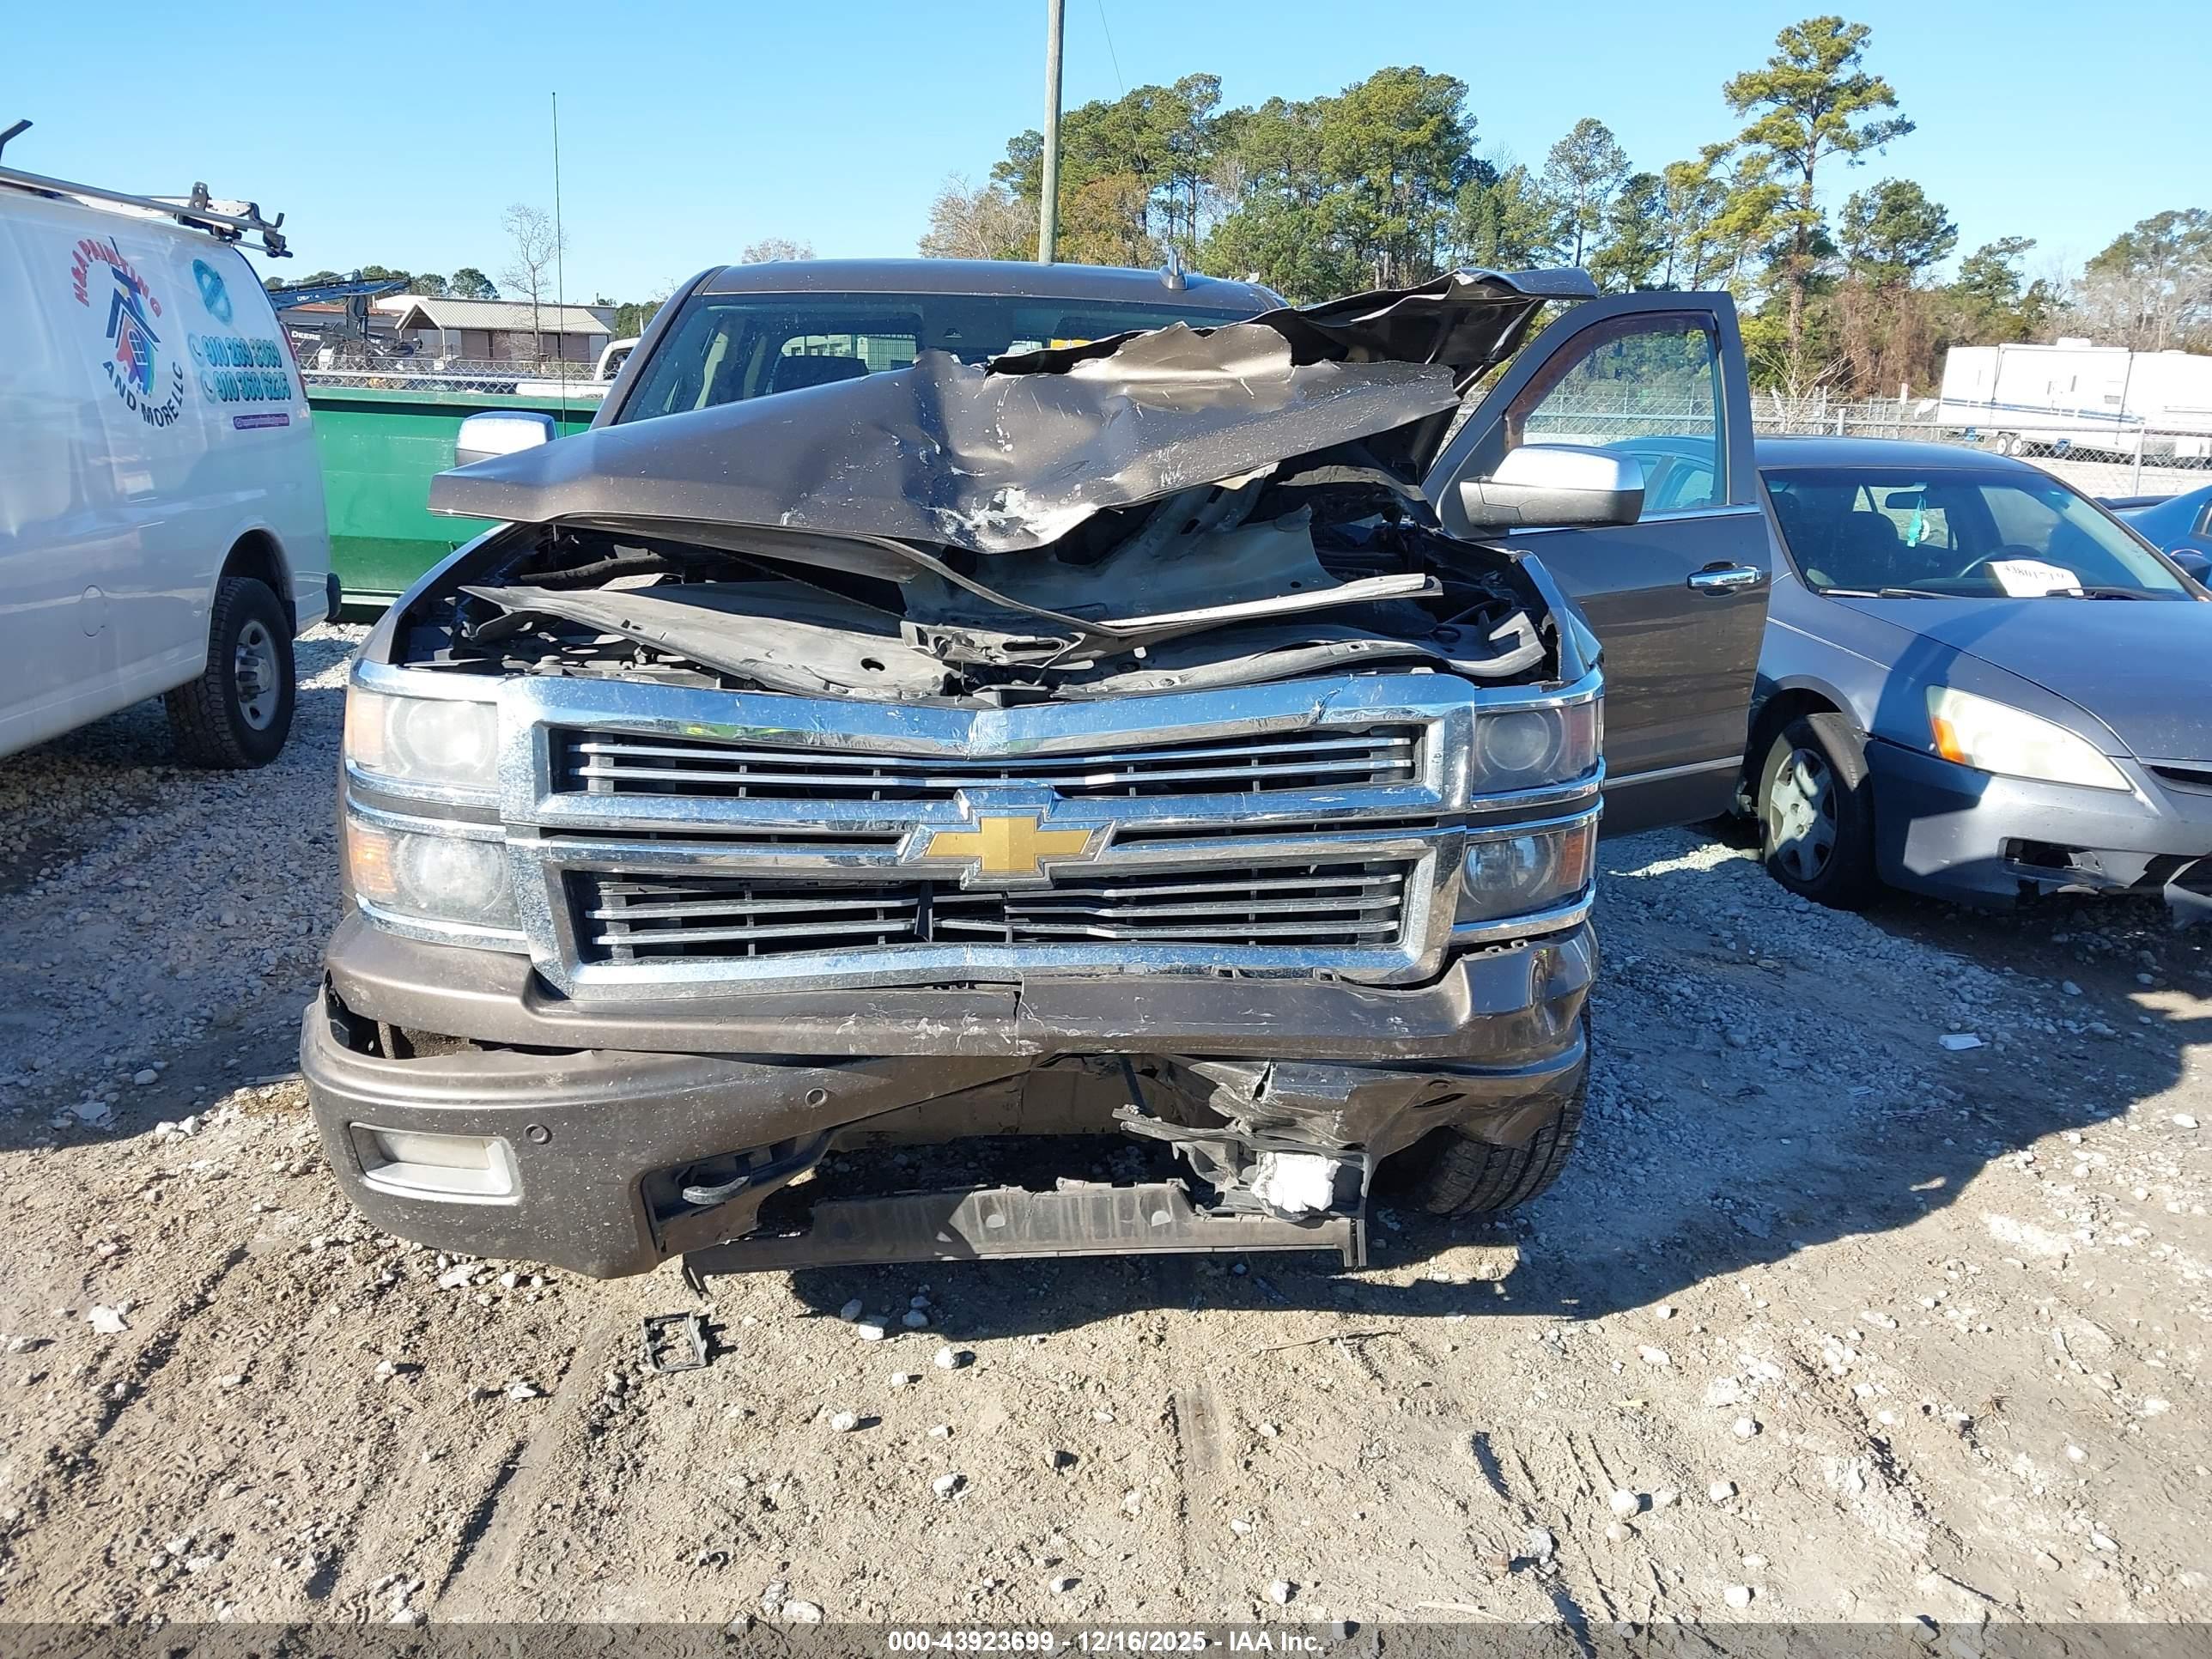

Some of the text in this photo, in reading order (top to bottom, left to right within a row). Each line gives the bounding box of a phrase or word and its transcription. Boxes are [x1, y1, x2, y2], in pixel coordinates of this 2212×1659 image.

[78, 240, 162, 318] PAINTING
[202, 336, 229, 367] 910
[291, 331, 321, 341] DEERE
[103, 361, 184, 427] AND MORE LLC
[213, 371, 240, 402] 910
